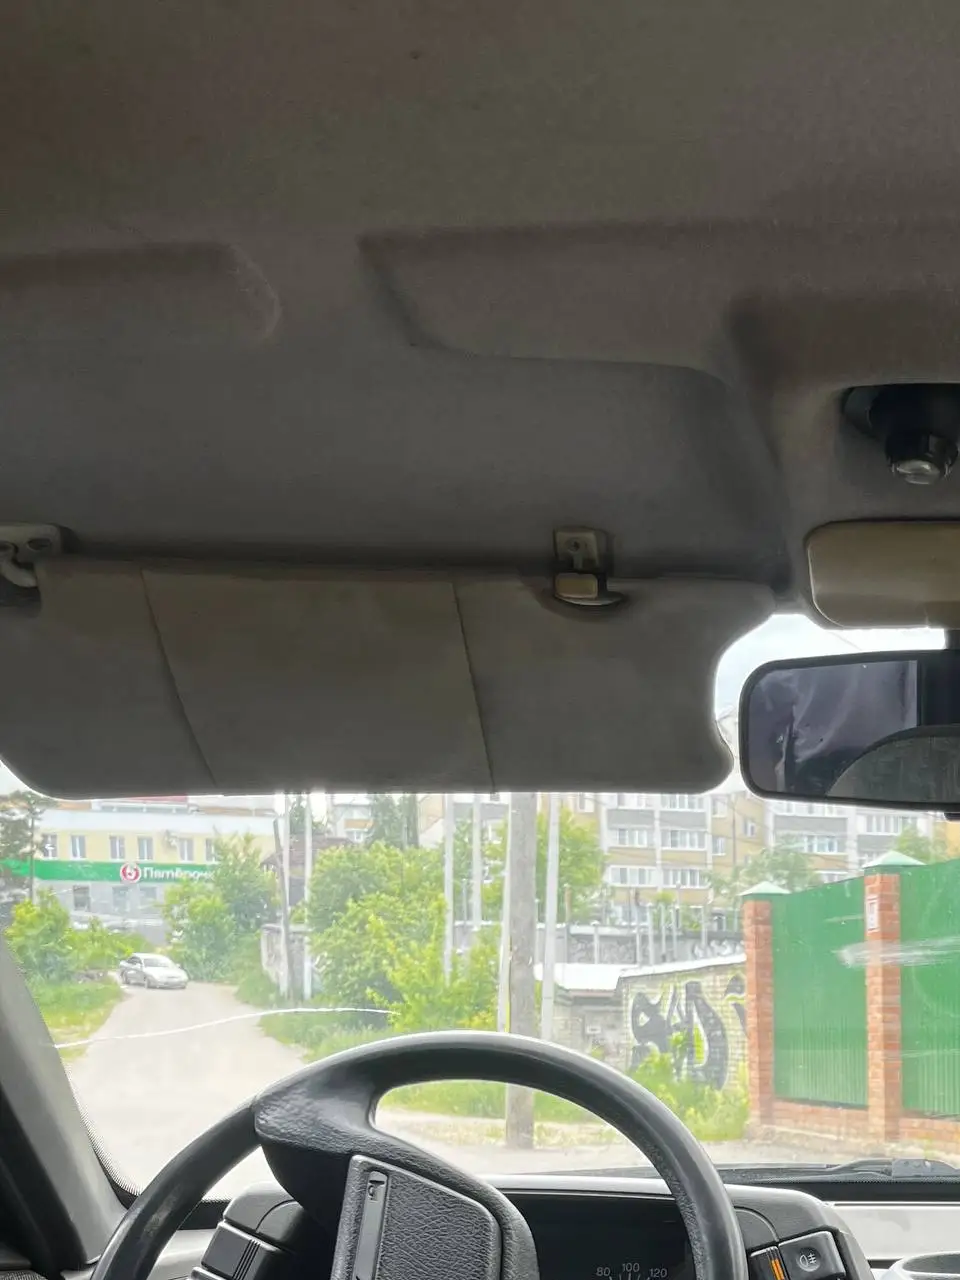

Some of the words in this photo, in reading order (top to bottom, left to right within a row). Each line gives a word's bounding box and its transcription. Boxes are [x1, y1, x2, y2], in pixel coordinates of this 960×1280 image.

[596, 1267, 611, 1277] 80
[622, 1262, 640, 1273] 100
[649, 1268, 668, 1278] 120
